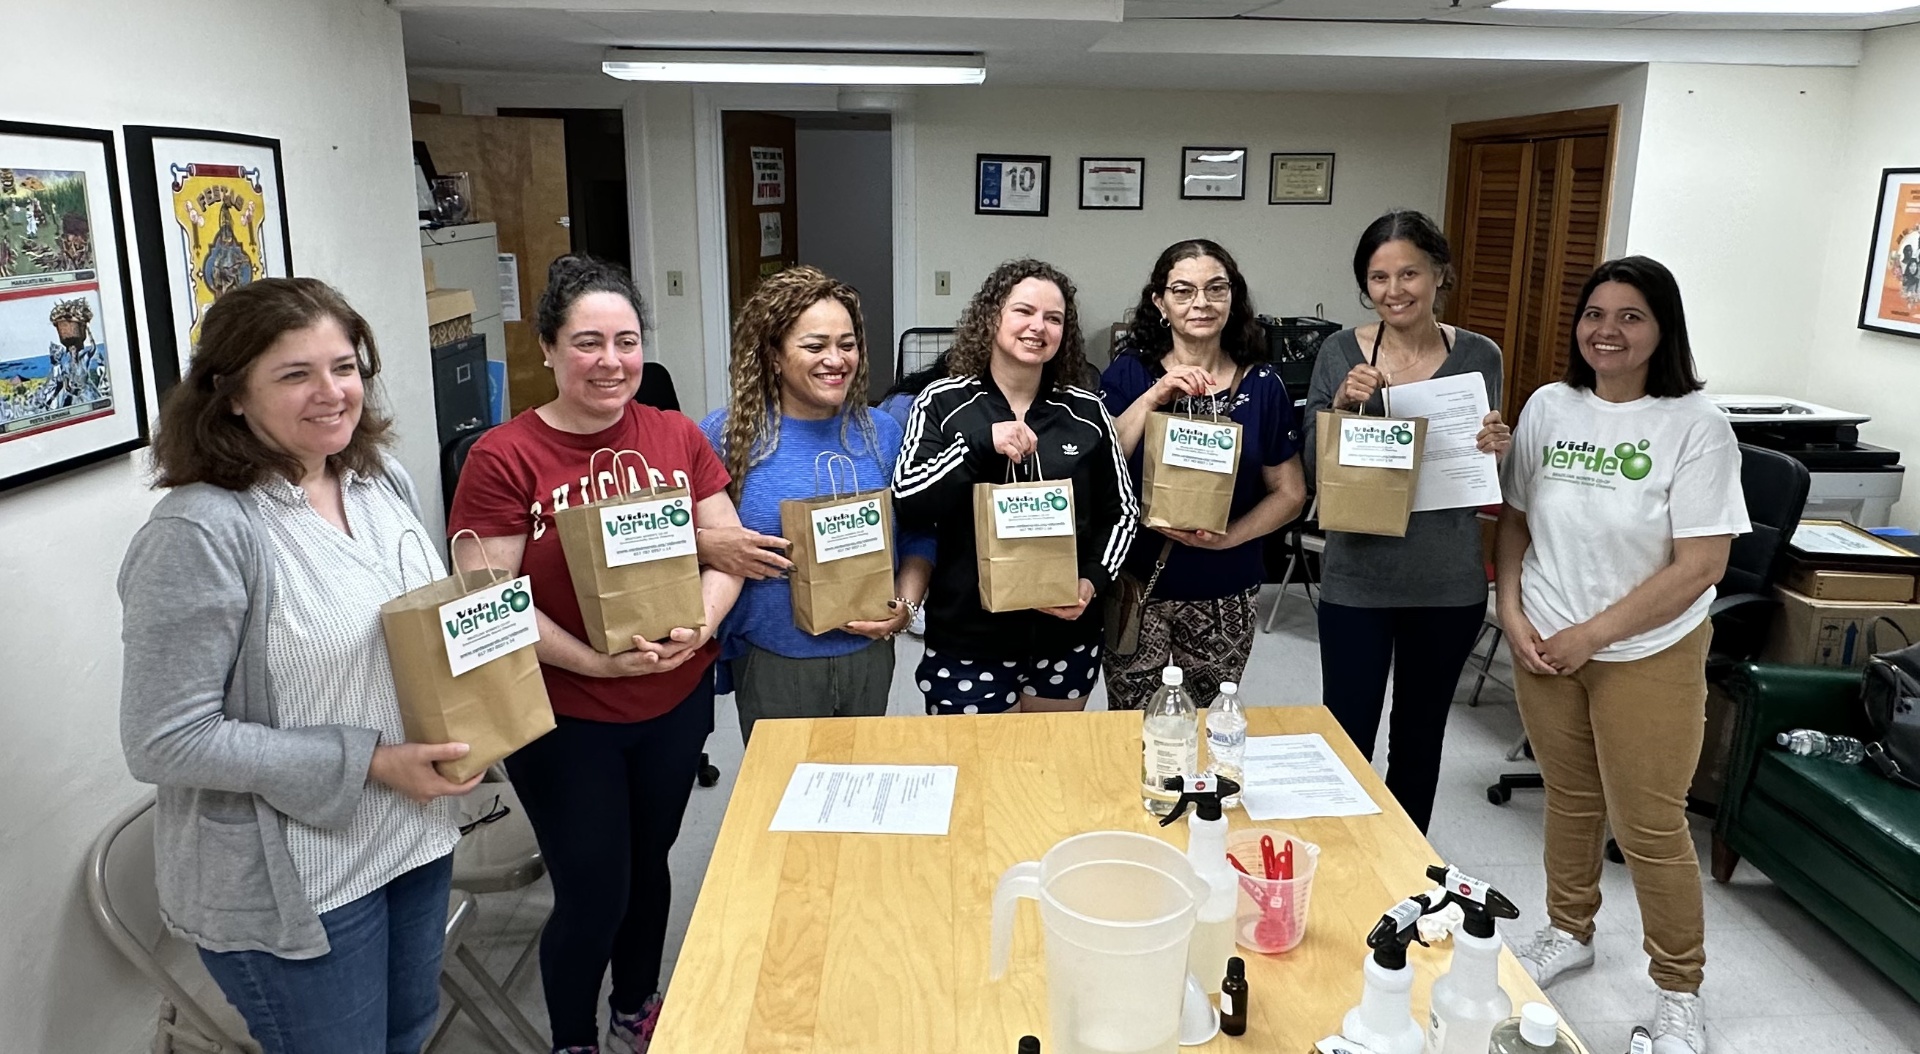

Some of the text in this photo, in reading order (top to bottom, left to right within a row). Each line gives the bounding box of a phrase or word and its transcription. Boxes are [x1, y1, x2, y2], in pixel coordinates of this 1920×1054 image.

[1005, 166, 1036, 192] 10
[1170, 429, 1217, 448] Verde
[1344, 429, 1395, 445] Verde
[1556, 440, 1596, 452] Vida
[1542, 446, 1619, 476] Verde
[997, 498, 1050, 514] Verde
[605, 513, 669, 537] Verde
[617, 512, 649, 521] Vida
[816, 514, 865, 536] Verde
[446, 601, 510, 639] Verde
[456, 602, 490, 619] Vida
